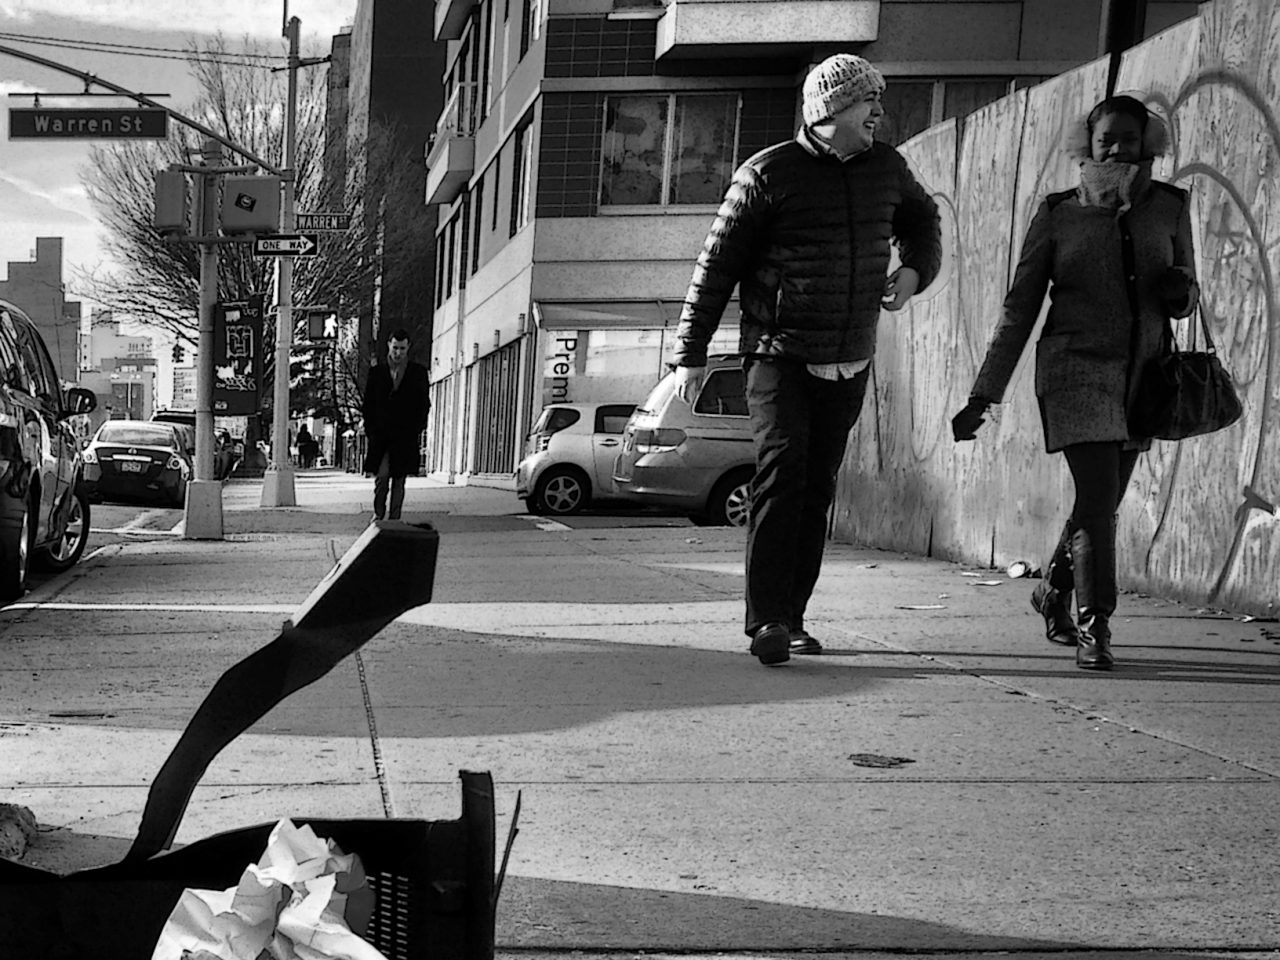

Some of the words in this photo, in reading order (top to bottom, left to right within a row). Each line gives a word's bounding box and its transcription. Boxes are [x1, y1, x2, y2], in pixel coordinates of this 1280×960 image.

[34, 115, 112, 132] Warren
[120, 115, 142, 132] St
[298, 216, 338, 229] WARREN
[262, 241, 281, 249] ONE
[289, 241, 308, 249] WAY
